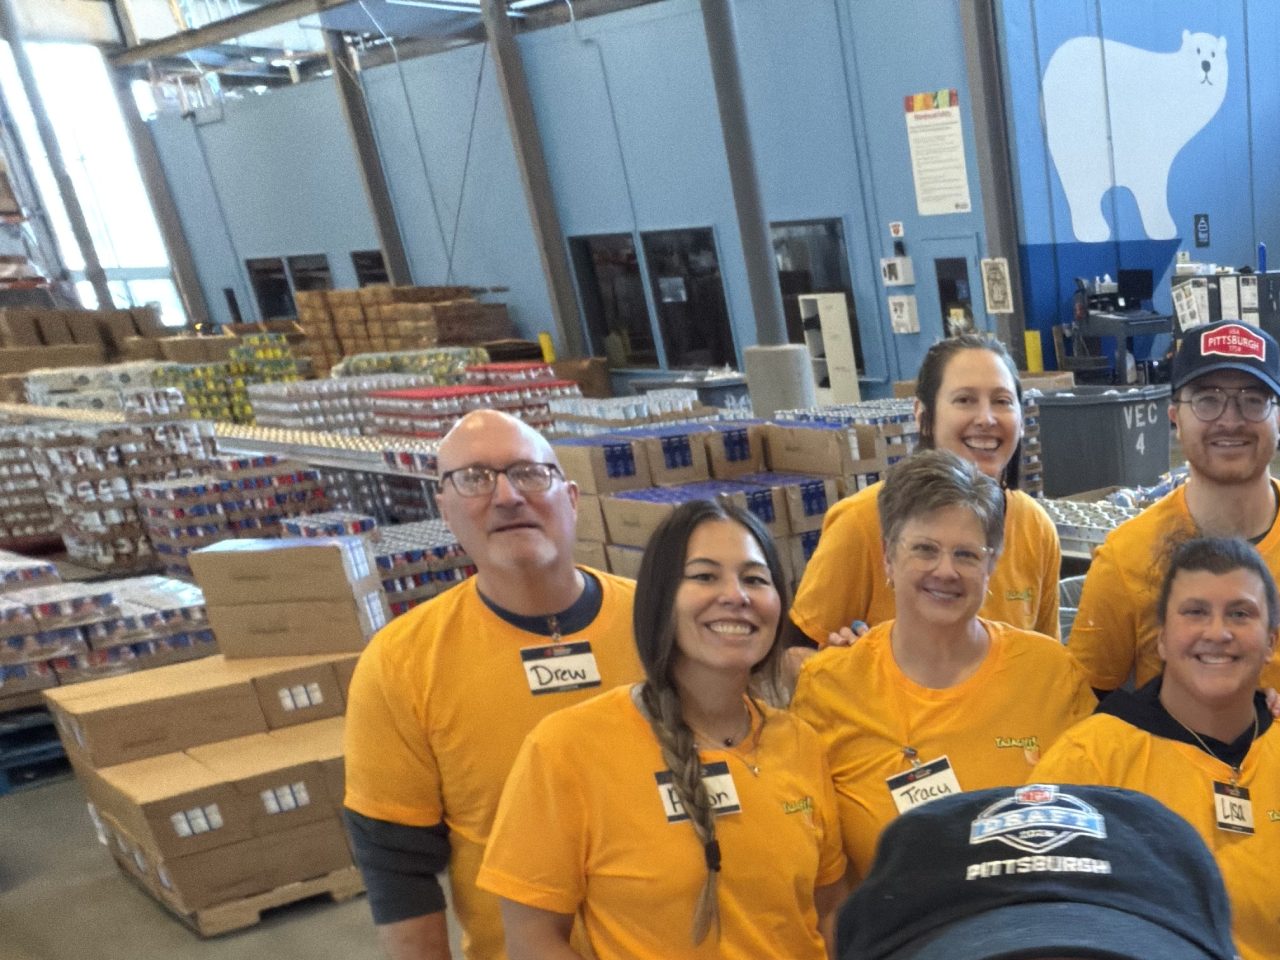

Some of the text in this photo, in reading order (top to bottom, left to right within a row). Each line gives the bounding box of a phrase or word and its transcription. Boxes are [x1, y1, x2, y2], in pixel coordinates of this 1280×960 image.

[1207, 334, 1260, 351] PITTSBURGH
[1123, 402, 1158, 430] VEC
[1135, 432, 1145, 456] 4
[529, 664, 587, 687] Drew
[981, 806, 1096, 835] DRAFT
[965, 854, 1112, 881] PITTSBURGH
